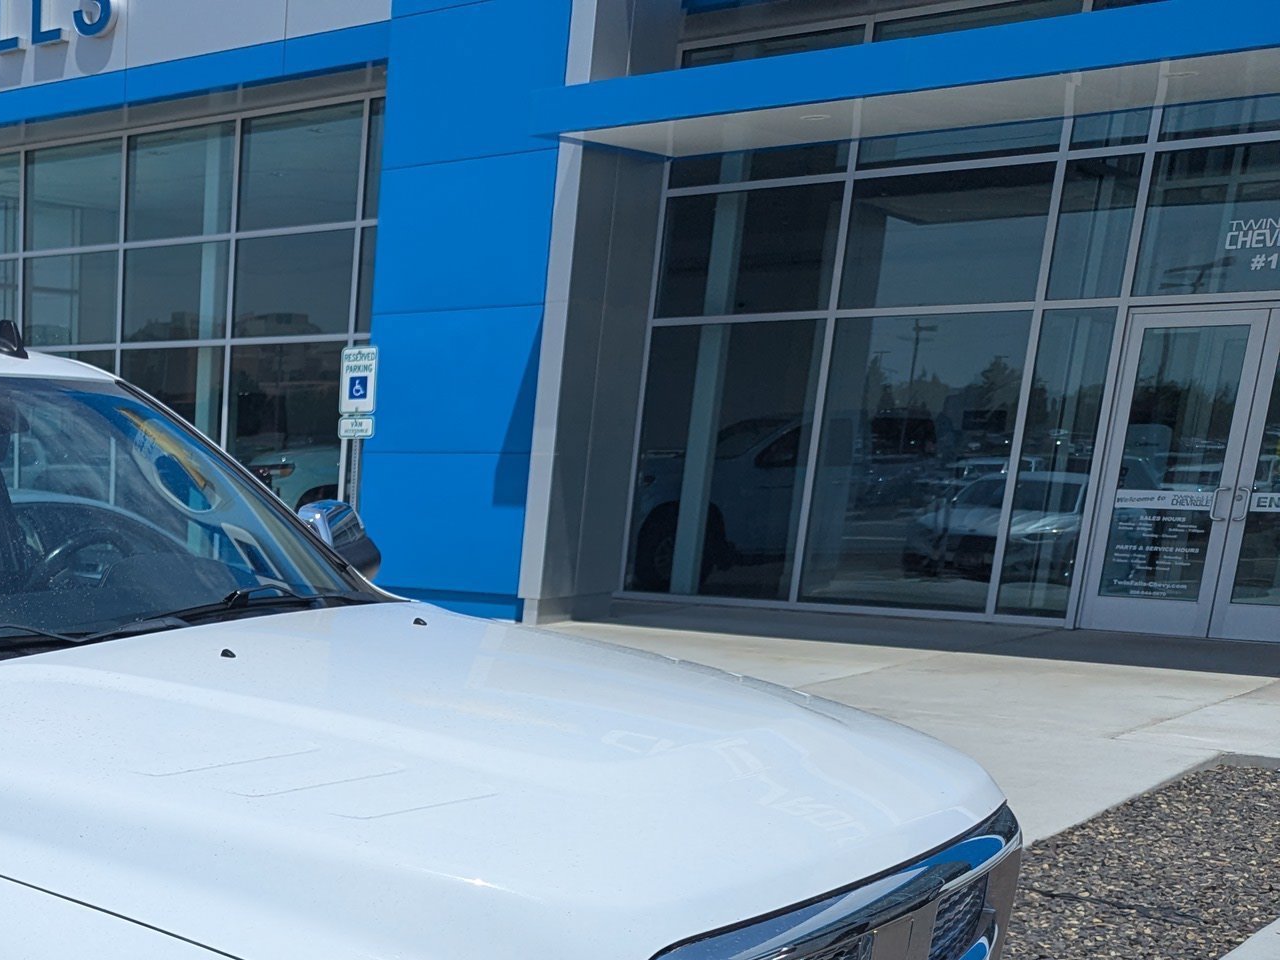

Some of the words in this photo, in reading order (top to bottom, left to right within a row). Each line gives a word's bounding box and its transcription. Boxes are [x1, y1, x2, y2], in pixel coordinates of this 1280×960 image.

[1225, 229, 1280, 249] CHEV
[344, 352, 376, 362] RESERVED
[346, 364, 373, 373] PARKING
[350, 421, 363, 429] VAN
[1171, 498, 1211, 507] CHEVROLE
